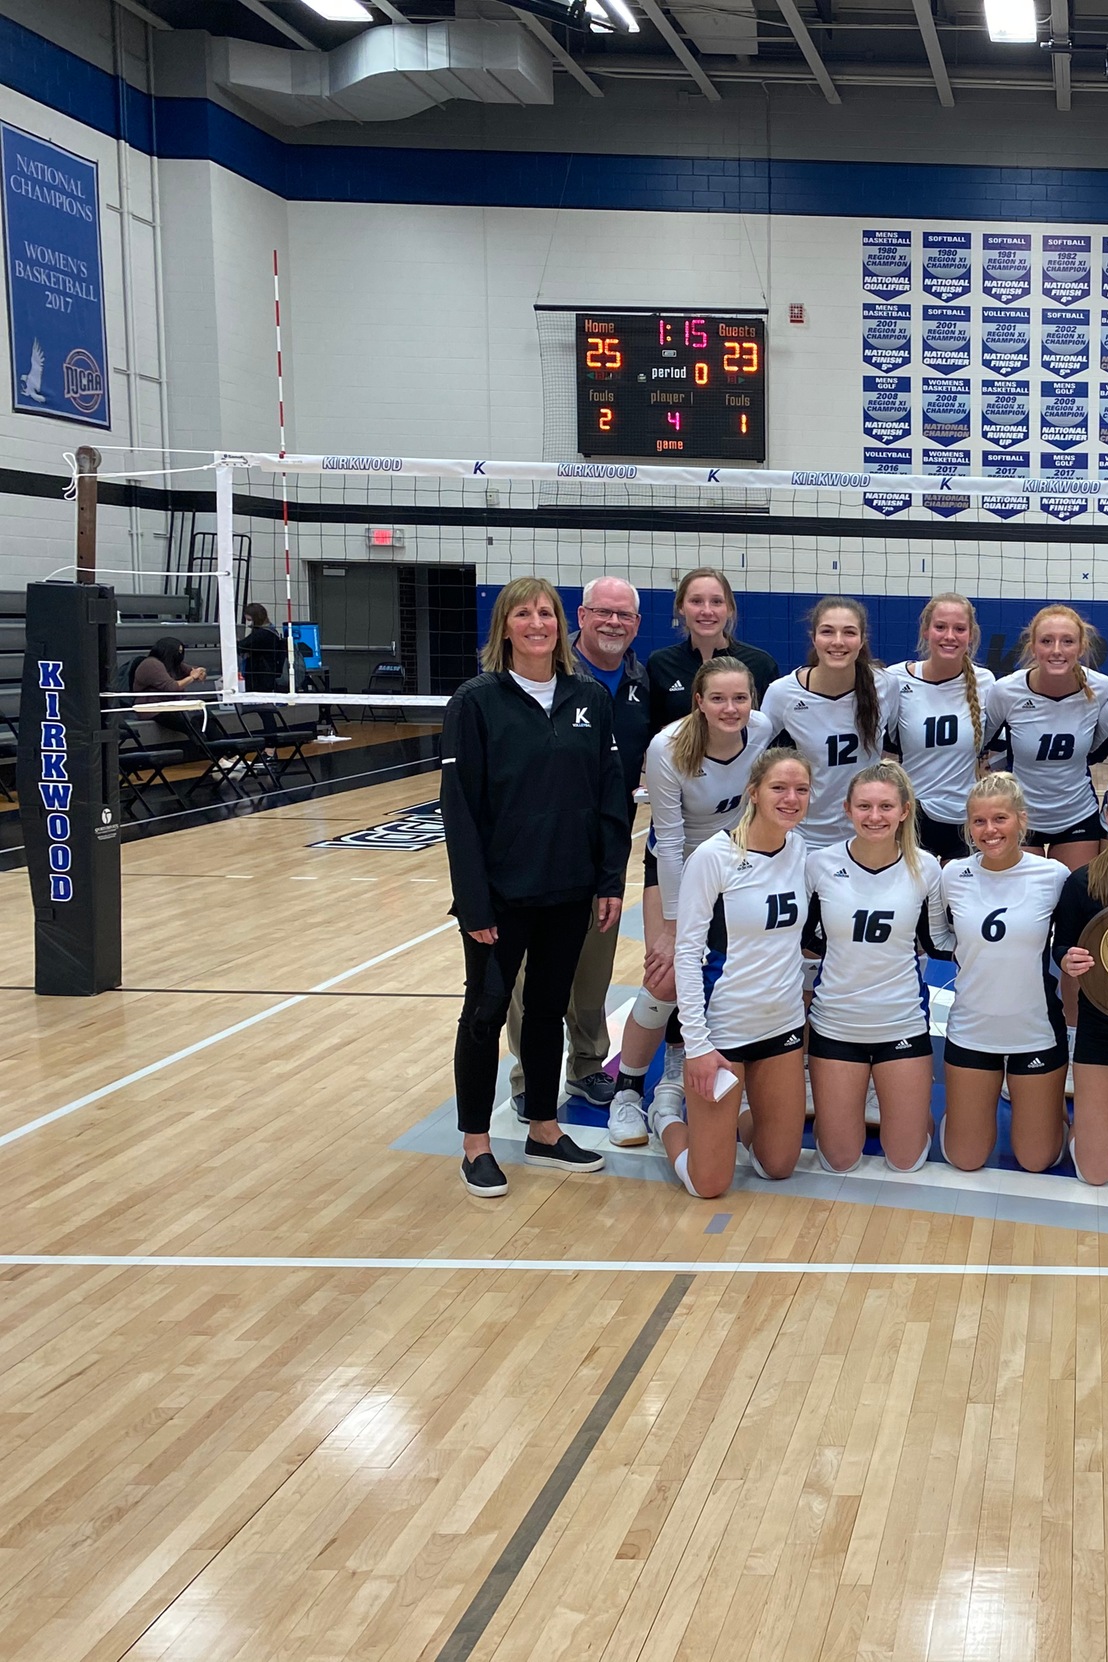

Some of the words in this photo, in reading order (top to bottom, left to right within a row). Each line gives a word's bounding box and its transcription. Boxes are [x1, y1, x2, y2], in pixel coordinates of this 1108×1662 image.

[16, 153, 86, 199] NATIONAL
[10, 174, 93, 222] CHAMPIONS
[24, 240, 88, 278] WOMEN'S
[15, 260, 98, 301] BASKETBALL
[45, 290, 73, 314] 2017
[585, 320, 614, 333] Home
[719, 323, 756, 338] Guests
[586, 338, 622, 368] 25
[723, 342, 758, 371] 23
[64, 364, 103, 398] NJCAA
[652, 366, 686, 380] period
[694, 363, 708, 385] 0
[589, 390, 614, 402] fouls
[651, 391, 685, 405] player
[725, 393, 750, 406] fouls
[599, 409, 612, 430] 2
[667, 411, 680, 431] 4
[741, 414, 747, 433] 1
[656, 439, 684, 451] game
[322, 457, 402, 471] KIRKWOOD
[473, 461, 486, 475] K
[558, 464, 637, 479] KIRKWOOD
[708, 469, 720, 483] K
[792, 472, 870, 487] KIRKWOOD
[940, 477, 952, 491] K
[1022, 480, 1100, 494] KIRKWOOD
[629, 685, 641, 703] K
[576, 707, 590, 724] K
[924, 714, 958, 748] 10
[825, 733, 858, 767] 12
[1036, 733, 1076, 761] 18
[38, 660, 73, 902] KIRKWOOD
[764, 890, 799, 931] 15
[852, 909, 895, 943] 16
[981, 907, 1007, 943] 6
